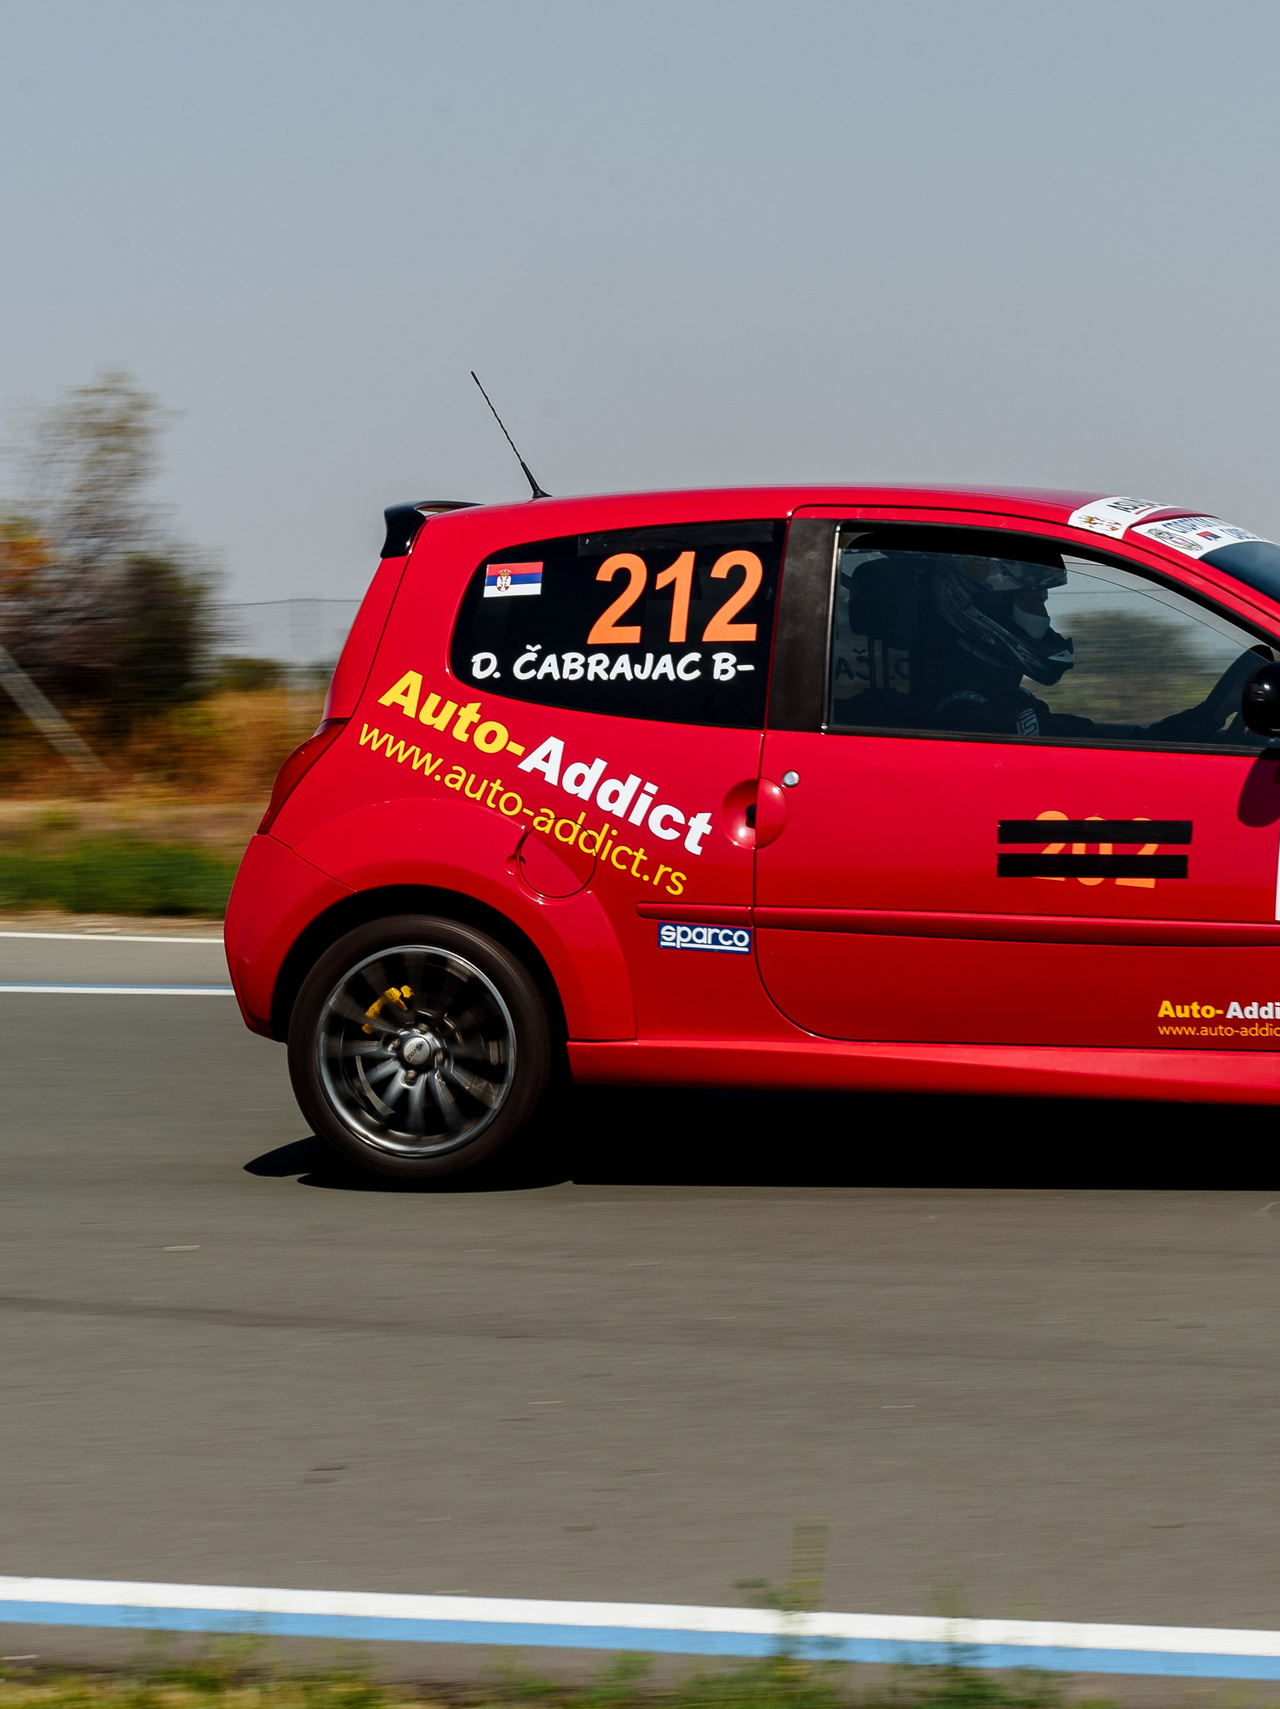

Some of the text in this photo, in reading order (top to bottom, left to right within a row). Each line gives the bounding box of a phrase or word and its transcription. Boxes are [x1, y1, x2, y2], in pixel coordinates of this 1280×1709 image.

[586, 550, 763, 645] 212
[471, 644, 756, 682] D. ČABRAJAC B-
[358, 722, 688, 896] www.auto-addict.rs
[377, 669, 714, 857] Auto-Addict
[660, 924, 750, 949] sparco
